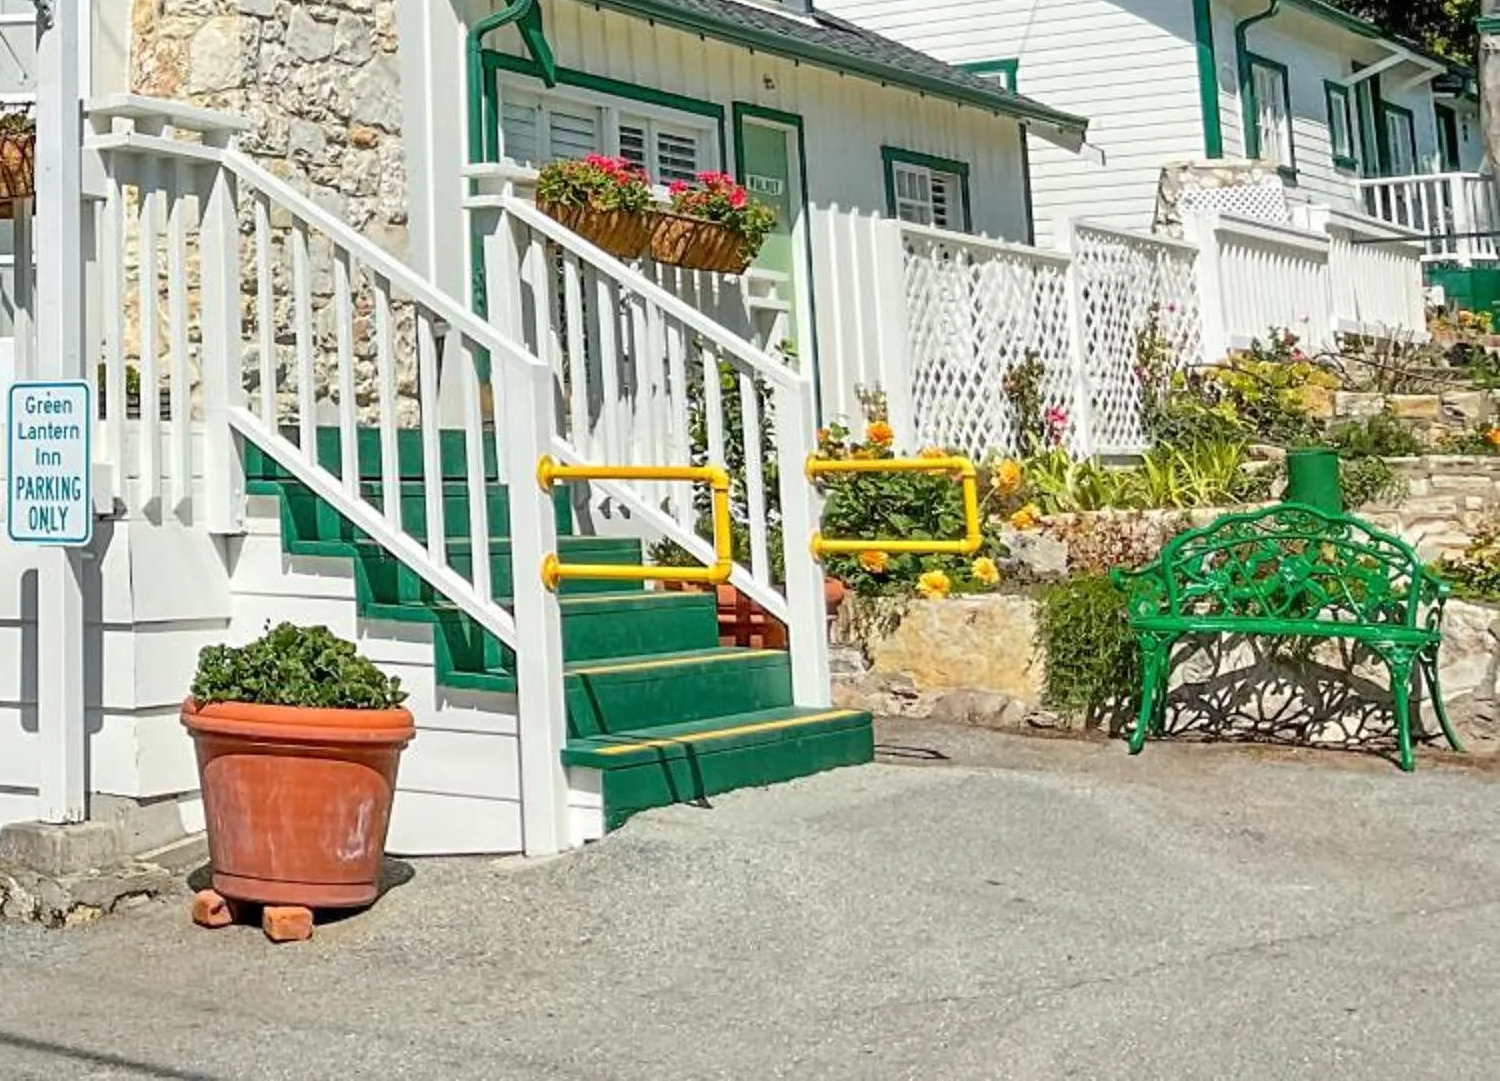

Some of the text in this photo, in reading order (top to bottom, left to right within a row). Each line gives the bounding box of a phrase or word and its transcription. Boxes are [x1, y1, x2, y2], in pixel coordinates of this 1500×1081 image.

[25, 396, 73, 414] Green
[17, 422, 79, 440] Lantern
[35, 448, 61, 465] Inn
[16, 475, 81, 501] PARKING
[28, 506, 68, 532] ONLY
